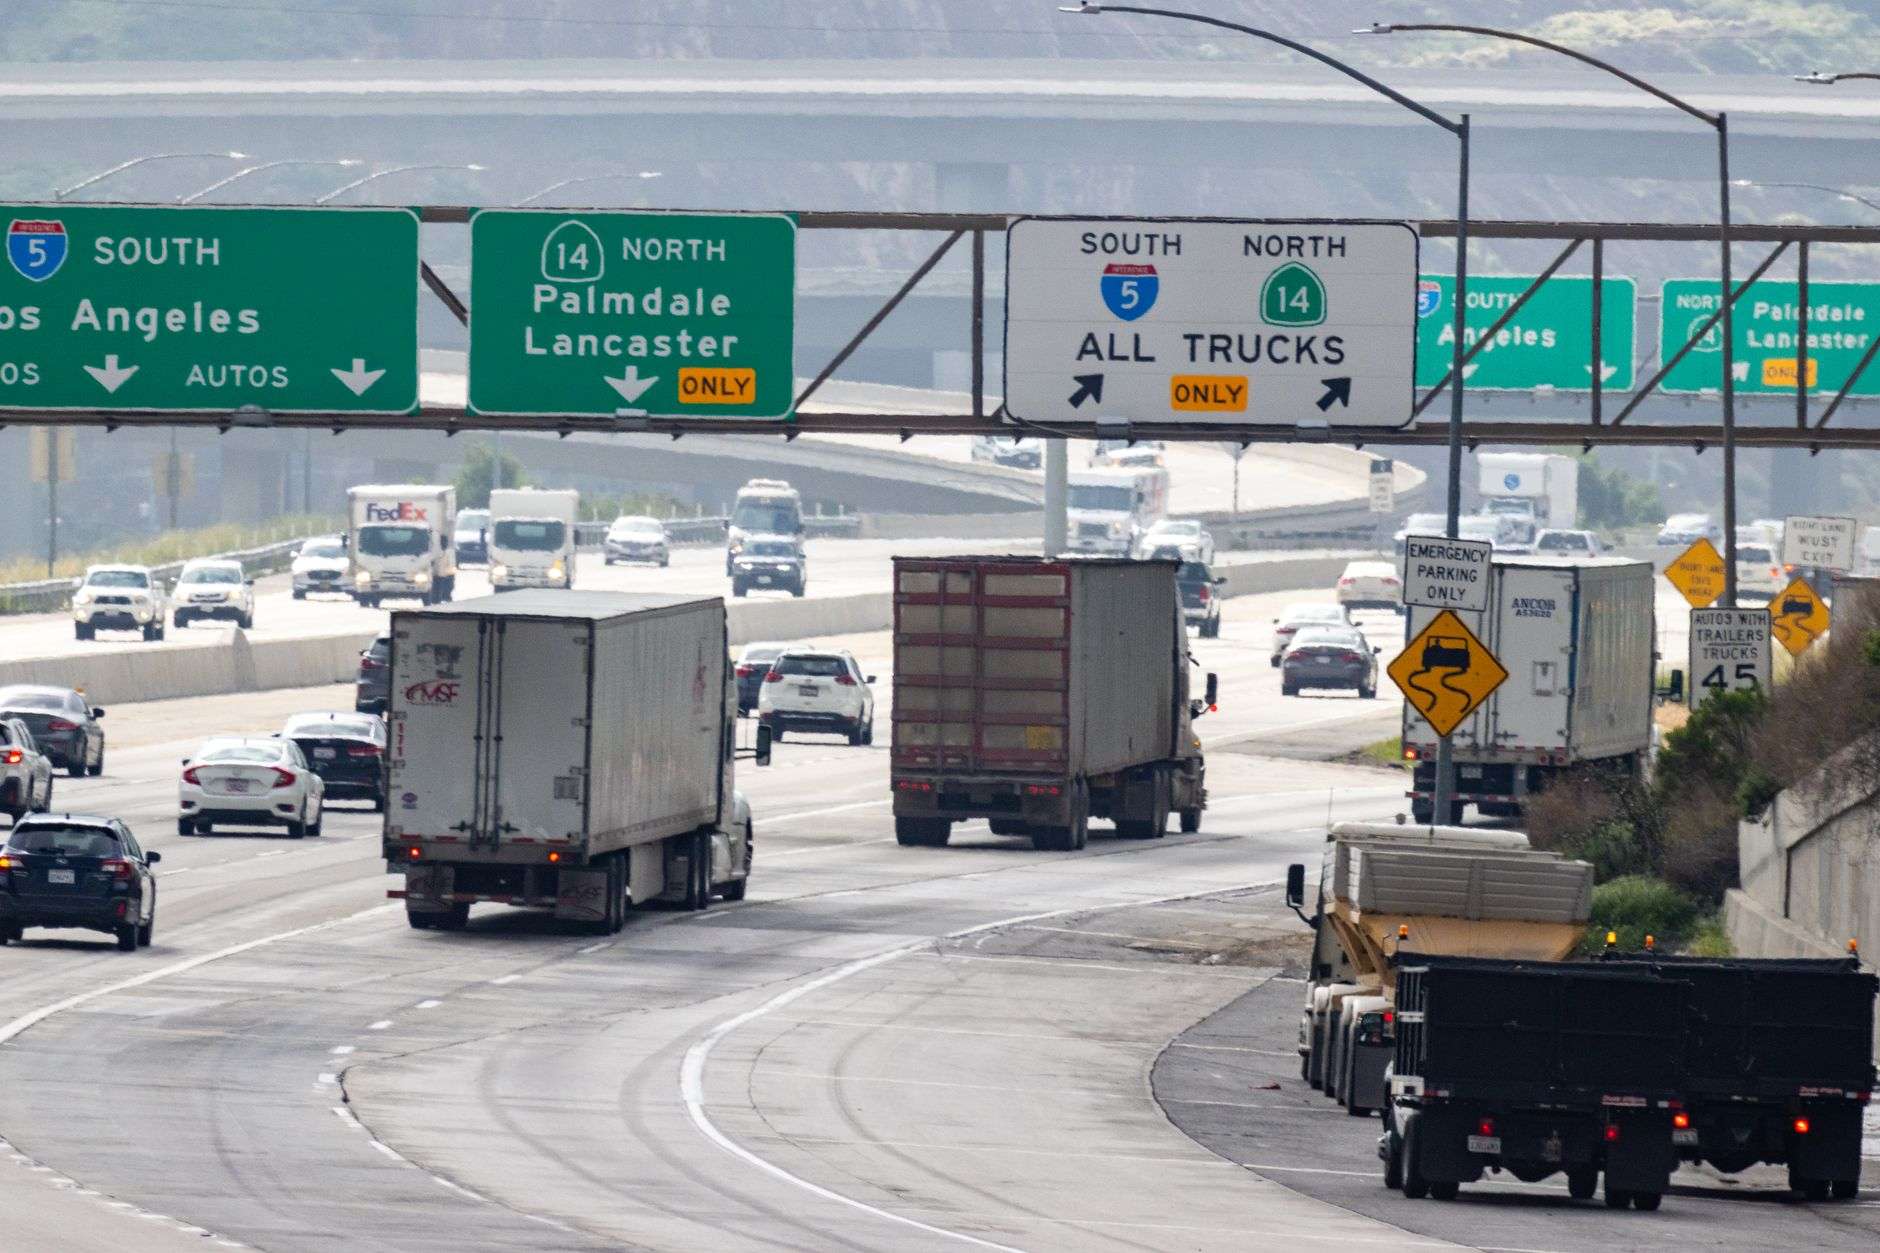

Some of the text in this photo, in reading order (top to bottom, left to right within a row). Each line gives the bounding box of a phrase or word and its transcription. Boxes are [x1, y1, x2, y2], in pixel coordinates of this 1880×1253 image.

[29, 239, 47, 267] 5
[94, 237, 220, 265] SOUTH
[622, 237, 726, 261] NORTH
[1081, 233, 1182, 255] SOUTH
[1244, 235, 1346, 257] NORTH
[558, 243, 589, 270] 14
[533, 284, 731, 316] Palmdale
[1121, 281, 1139, 309] 5
[1278, 286, 1310, 313] 14
[1676, 294, 1736, 310] NORT
[70, 299, 260, 342] Angeles
[525, 326, 738, 358] Lancaster
[1076, 333, 1346, 365] ALL TRUCKS
[1747, 330, 1869, 349] Lanaster
[0, 363, 40, 385] OS
[186, 364, 289, 388] AUTOS
[683, 376, 751, 396] ONLY
[1175, 384, 1243, 404] ONLY
[367, 502, 427, 522] FedEx
[1409, 543, 1487, 563] EMERGENCY
[1418, 565, 1478, 583] PARKING
[1427, 585, 1466, 600] ONLY
[1694, 613, 1767, 625] AUTOS WITH
[1696, 629, 1764, 641] TRAILERS
[1702, 647, 1759, 660] TRUCKS
[1702, 663, 1758, 691] 45
